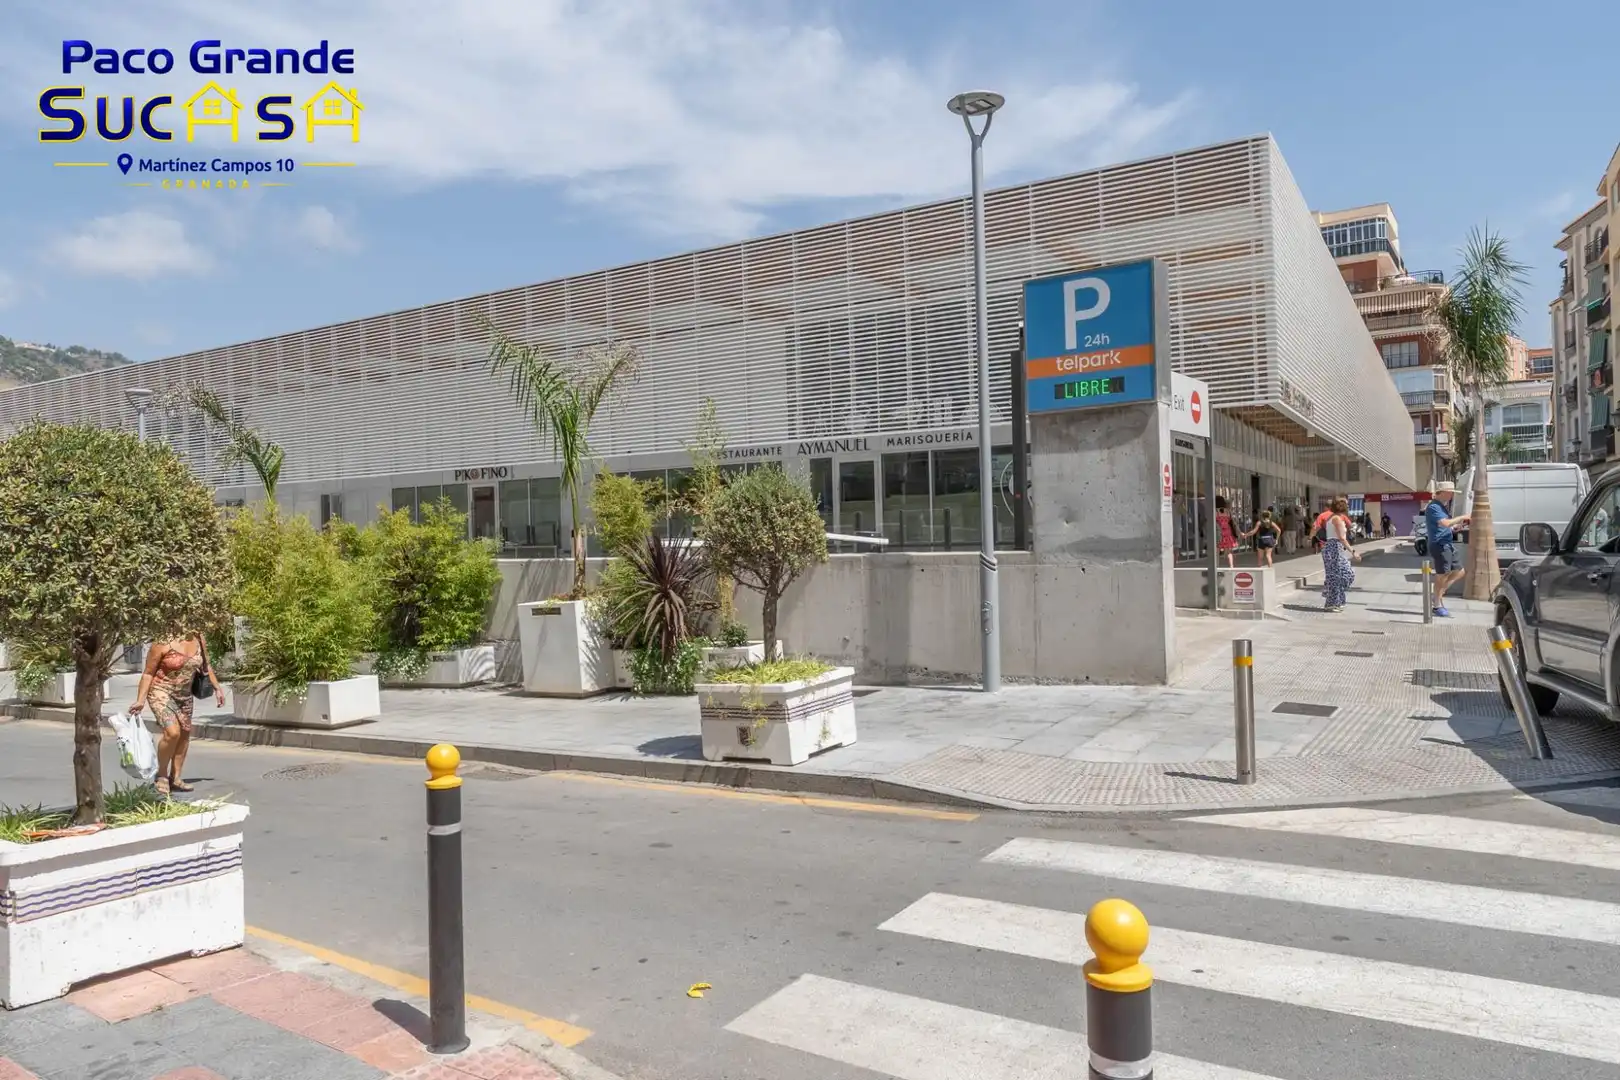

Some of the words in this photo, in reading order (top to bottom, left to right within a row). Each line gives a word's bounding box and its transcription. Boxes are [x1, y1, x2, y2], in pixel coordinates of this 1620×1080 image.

[1063, 277, 1111, 350] P
[1084, 333, 1110, 348] 24h
[1056, 350, 1121, 373] telpark
[1064, 378, 1111, 399] LIBRE
[1174, 394, 1185, 411] Exit
[797, 438, 871, 456] AYMANUEL
[886, 429, 973, 447] MARISQUERÍA
